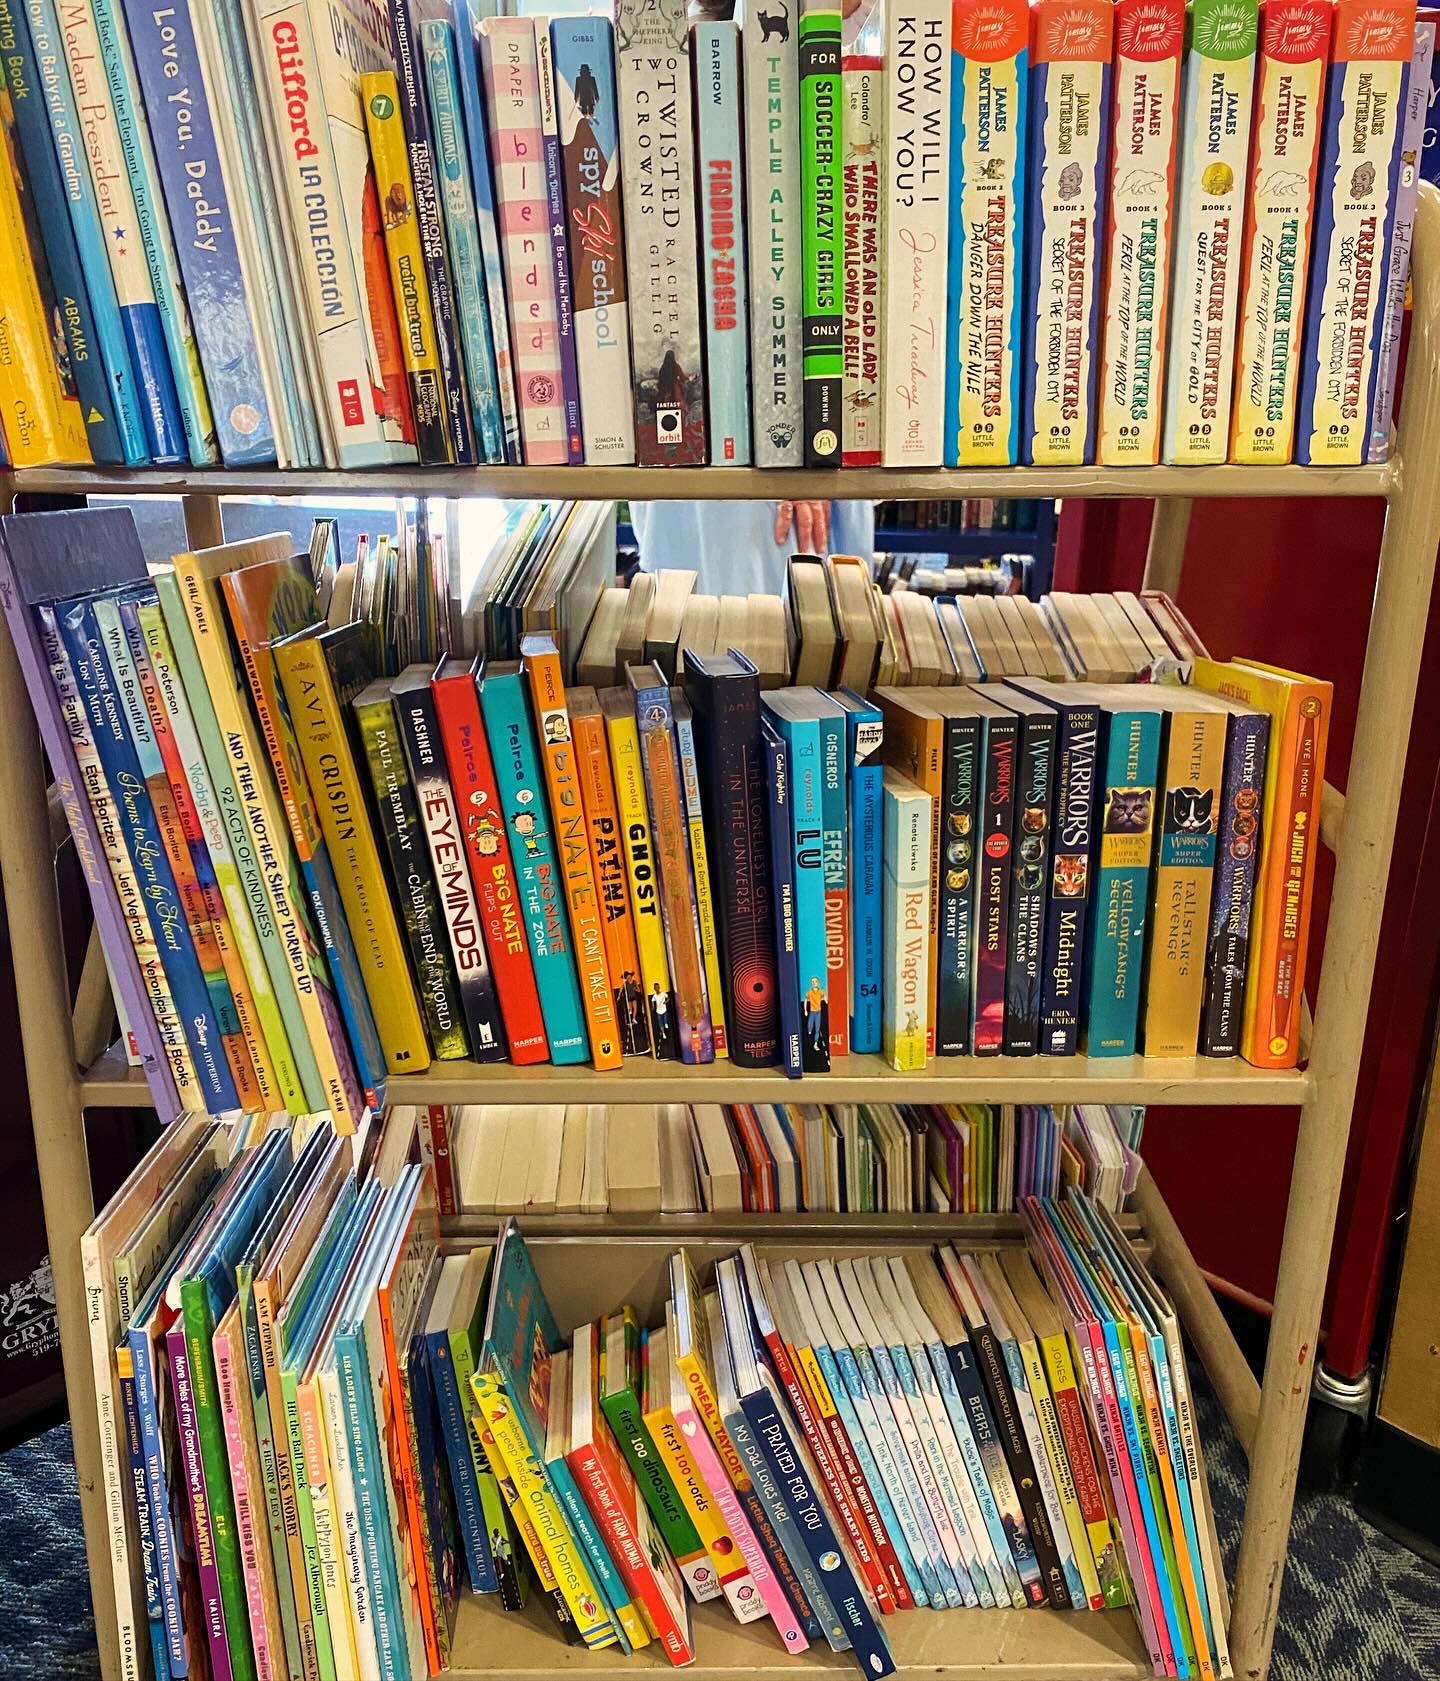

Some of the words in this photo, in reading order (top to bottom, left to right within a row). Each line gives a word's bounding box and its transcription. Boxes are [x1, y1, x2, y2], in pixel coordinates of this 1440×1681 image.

[507, 43, 524, 108] DRAPER
[632, 58, 677, 71] TWO
[711, 39, 722, 105] BARROW
[811, 54, 836, 64] FOR
[897, 17, 916, 114] KNOW
[924, 21, 942, 94] HOW
[60, 3, 88, 98] Madam
[81, 104, 120, 218] President
[272, 21, 319, 160] Clifford
[375, 100, 387, 116] 7
[861, 75, 870, 127] Colandro/
[978, 67, 991, 152] PATTERSON
[993, 88, 1007, 133] JAMES
[1208, 73, 1225, 154] PATTERSON
[1225, 92, 1239, 135] JAMES
[39, 55, 65, 116] Babysit
[56, 132, 82, 201] Grandma
[152, 8, 180, 78] Love
[167, 88, 193, 152] You,
[184, 159, 218, 253] Daddy
[767, 57, 782, 173] TEMPLE
[636, 91, 654, 214] CROWNS
[657, 74, 680, 228] TWISTED
[816, 81, 834, 241] SOCCER-CRAZY
[896, 130, 915, 207] YOU?
[922, 109, 940, 183] WILL
[299, 165, 322, 188] LA
[416, 141, 434, 197] TRISTAN
[425, 200, 443, 257] STRONG
[844, 165, 858, 209] WHO
[862, 161, 878, 223] THERE
[304, 194, 345, 317] COLECCIÓN
[579, 147, 600, 197] spy
[592, 259, 617, 348] school
[769, 189, 785, 281] ALLEY
[861, 225, 878, 264] WAS
[970, 222, 983, 279] DANGER
[1121, 234, 1133, 271] PERIL
[399, 256, 416, 297] weird
[816, 250, 834, 309] GIRLS
[843, 212, 860, 315] SWALLOWED
[863, 269, 877, 296] AN
[898, 228, 937, 313] Jessica
[406, 298, 420, 321] but
[650, 246, 662, 334] GILLIG
[666, 239, 679, 339] RACHEL
[970, 282, 982, 327] DOWN
[63, 296, 89, 361] ABRAMS
[410, 321, 426, 357] true!
[812, 326, 839, 336] ONLY
[844, 318, 860, 330] A
[863, 301, 876, 337] OLD
[772, 297, 787, 405] SUMMER
[844, 335, 860, 378] BELL!
[862, 345, 878, 384] LADY
[969, 329, 982, 358] THE
[966, 362, 981, 394] NILE
[659, 434, 681, 442] orbit
[766, 423, 796, 435] YONDER
[185, 575, 208, 635] GEHL/ADELE
[43, 630, 63, 667] What
[63, 695, 90, 747] Family?
[87, 639, 109, 691] CAROLINE
[102, 690, 125, 742] KENNEDY
[106, 627, 123, 662] What
[122, 680, 150, 743] Beautiful?
[147, 629, 160, 647] Liu
[158, 664, 180, 715] Peterson
[544, 666, 556, 702] PEIRCE
[144, 686, 167, 734] Death?
[1068, 713, 1093, 721] BOOK
[299, 679, 325, 728] AVI
[318, 753, 357, 841] CRISPIN
[411, 709, 434, 765] DASHNER
[1126, 720, 1141, 781] HUNTER
[1242, 734, 1256, 782] HUNTER
[826, 734, 838, 789] CISNEROS
[864, 774, 874, 792] THE
[375, 730, 389, 769] PAUL
[385, 772, 412, 850] TREMBLAY
[423, 789, 446, 799] THE
[1062, 730, 1097, 846] WARRIORS
[426, 799, 460, 864] EYE
[863, 795, 874, 851] MYSTERIOUS
[911, 813, 919, 842] Renata
[248, 801, 277, 872] ANOTHER
[268, 873, 290, 918] SHEEP
[442, 862, 458, 873] OF
[523, 867, 534, 880] IN
[592, 818, 626, 923] PATINA
[629, 824, 656, 916] GHOST
[823, 830, 845, 884] EFRÉN
[863, 854, 874, 896] CARAVAN
[244, 867, 274, 938] KINDNESS
[527, 888, 540, 914] THE
[990, 868, 1001, 902] LOST
[442, 871, 482, 970] MINDS
[501, 903, 524, 955] NATE
[826, 899, 843, 970] DIVIDED
[905, 893, 922, 929] Red
[947, 899, 956, 937] SPIRIT
[987, 908, 1000, 950] STARS
[532, 922, 548, 956] ZONE
[957, 911, 967, 979] WARRIOR'S
[1053, 911, 1076, 996] Midnight
[860, 985, 877, 996] 54
[900, 938, 922, 1004] Wagon
[791, 1034, 800, 1067] HARPER
[119, 1276, 130, 1321] Shannon
[259, 1298, 269, 1323] SAM
[262, 1324, 275, 1367] ZUPPARDI
[774, 1347, 788, 1372] KETCH
[957, 1352, 969, 1369] 1
[1052, 1346, 1067, 1384] JONES
[689, 1372, 715, 1419] O'NEAL
[714, 1428, 744, 1476] TAYLOR
[757, 1414, 775, 1423] I
[619, 1409, 638, 1435] first
[631, 1437, 647, 1458] 100
[643, 1457, 682, 1523] dinosaurs
[762, 1425, 796, 1474] PRAYED
[134, 1468, 144, 1500] STEAM
[687, 1477, 709, 1512] words
[787, 1477, 808, 1503] FOR
[284, 1495, 298, 1538] WORRY
[798, 1502, 822, 1531] YOU
[530, 1491, 565, 1541] animal
[553, 1542, 580, 1591] homes
[621, 1536, 644, 1570] ANIMALS
[1013, 1533, 1028, 1559] LASKY
[310, 1561, 325, 1616] Alborough
[354, 1587, 366, 1624] Garden
[843, 1597, 863, 1628] Fischer
[208, 1598, 221, 1638] NAIURA
[1221, 1656, 1228, 1666] DK
